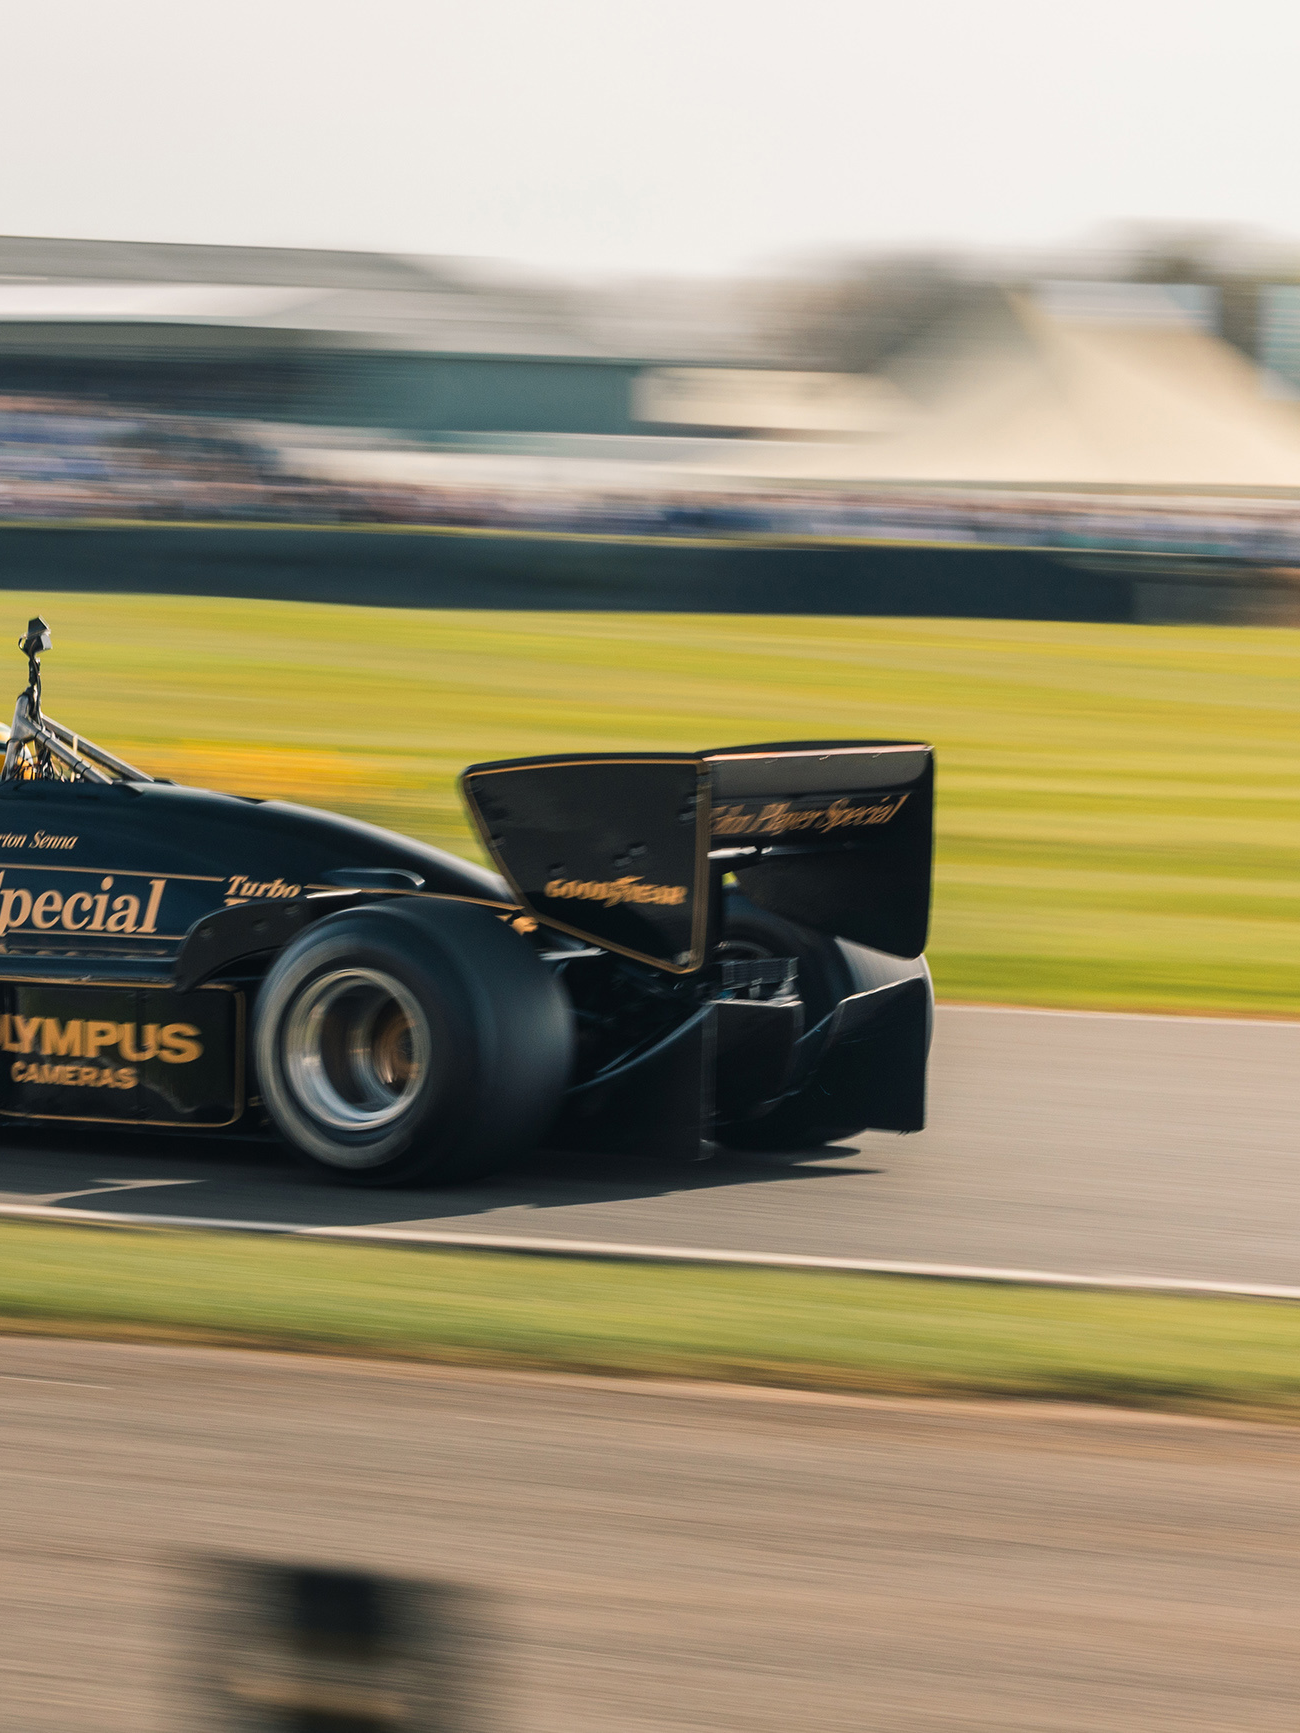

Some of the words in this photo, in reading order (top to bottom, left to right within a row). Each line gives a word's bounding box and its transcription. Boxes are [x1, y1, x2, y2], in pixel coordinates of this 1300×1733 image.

[819, 793, 912, 833] Special
[28, 829, 79, 850] Senna
[224, 874, 302, 898] Turbo
[11, 1060, 140, 1090] CAMERAS
